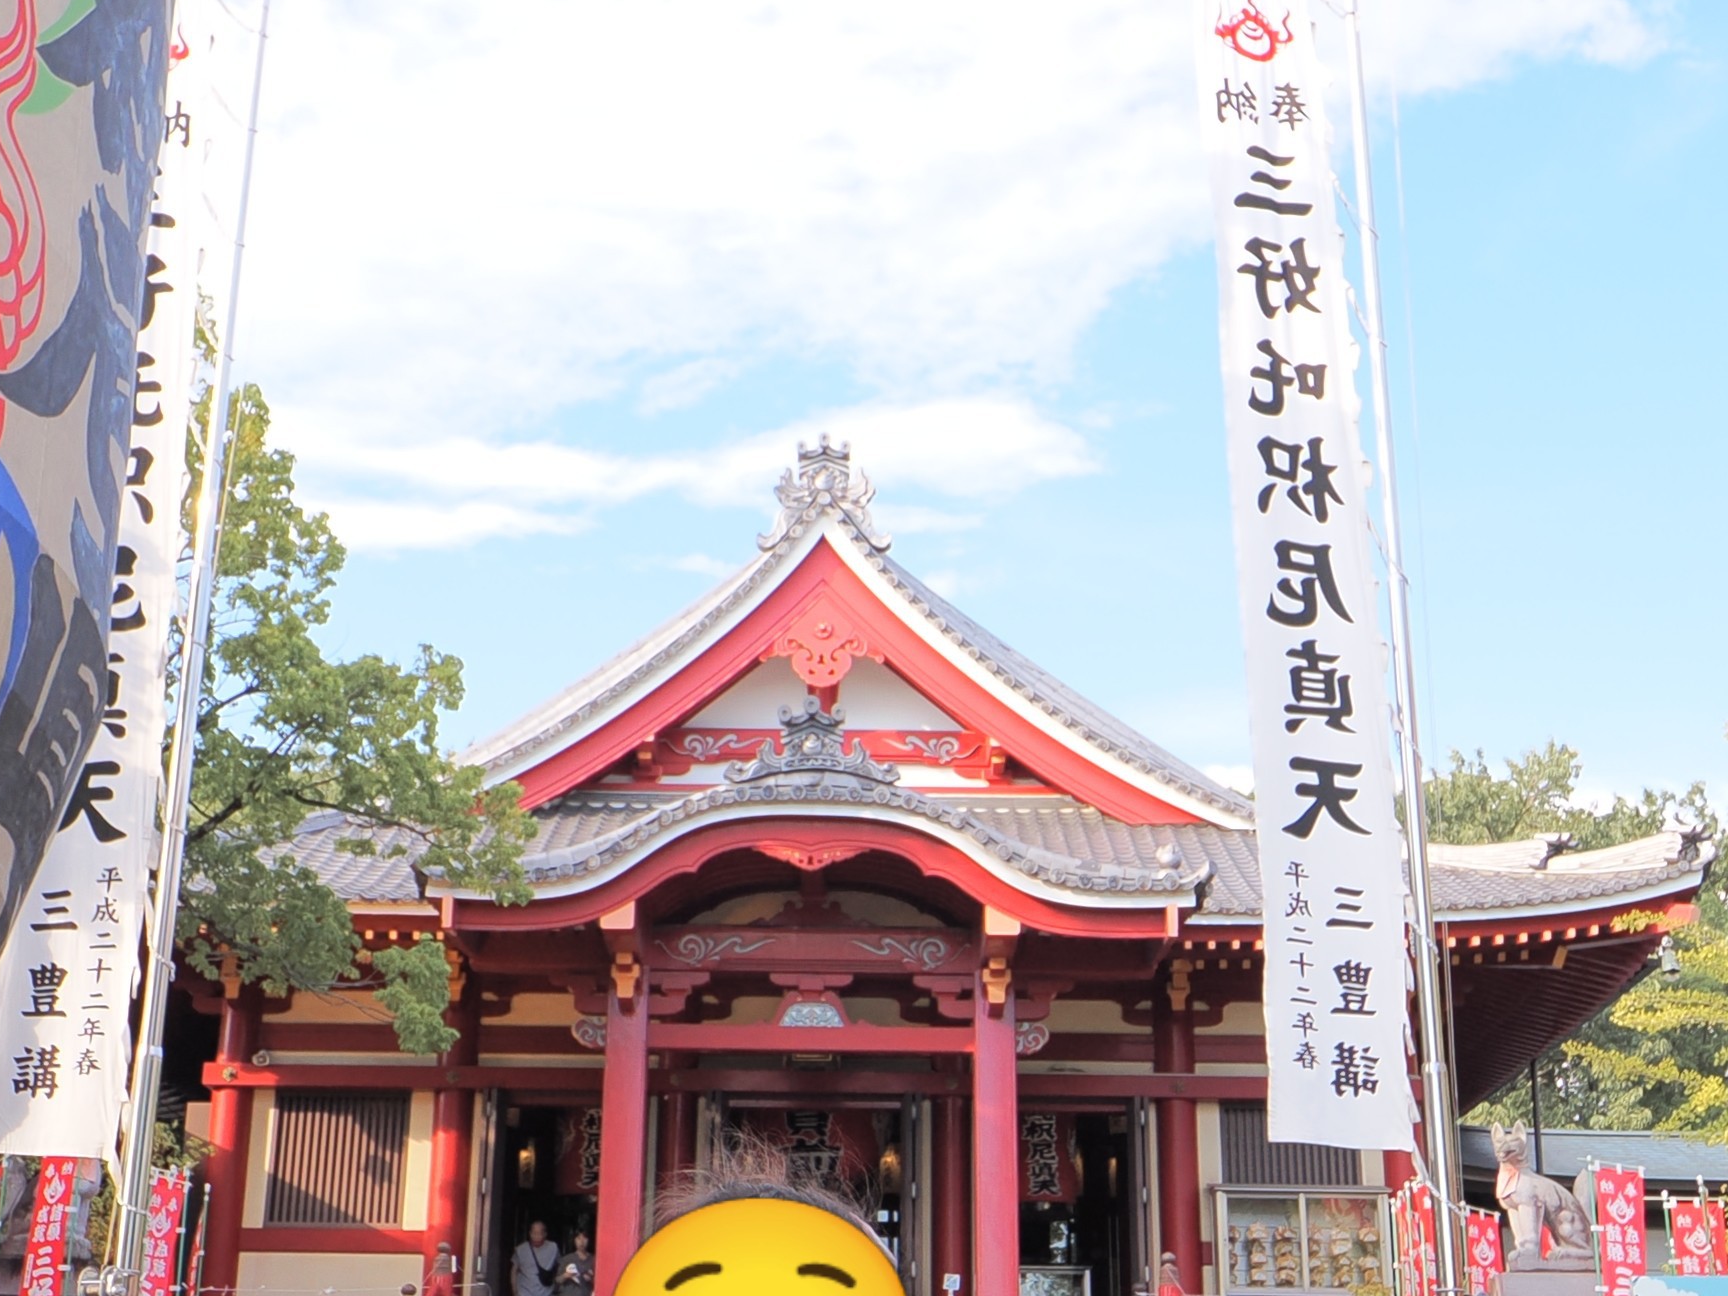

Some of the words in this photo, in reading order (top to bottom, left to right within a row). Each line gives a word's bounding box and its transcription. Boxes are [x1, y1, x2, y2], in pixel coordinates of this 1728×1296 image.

[11, 889, 79, 1100] 三豊講
[73, 866, 124, 1076] 平成二十二年春
